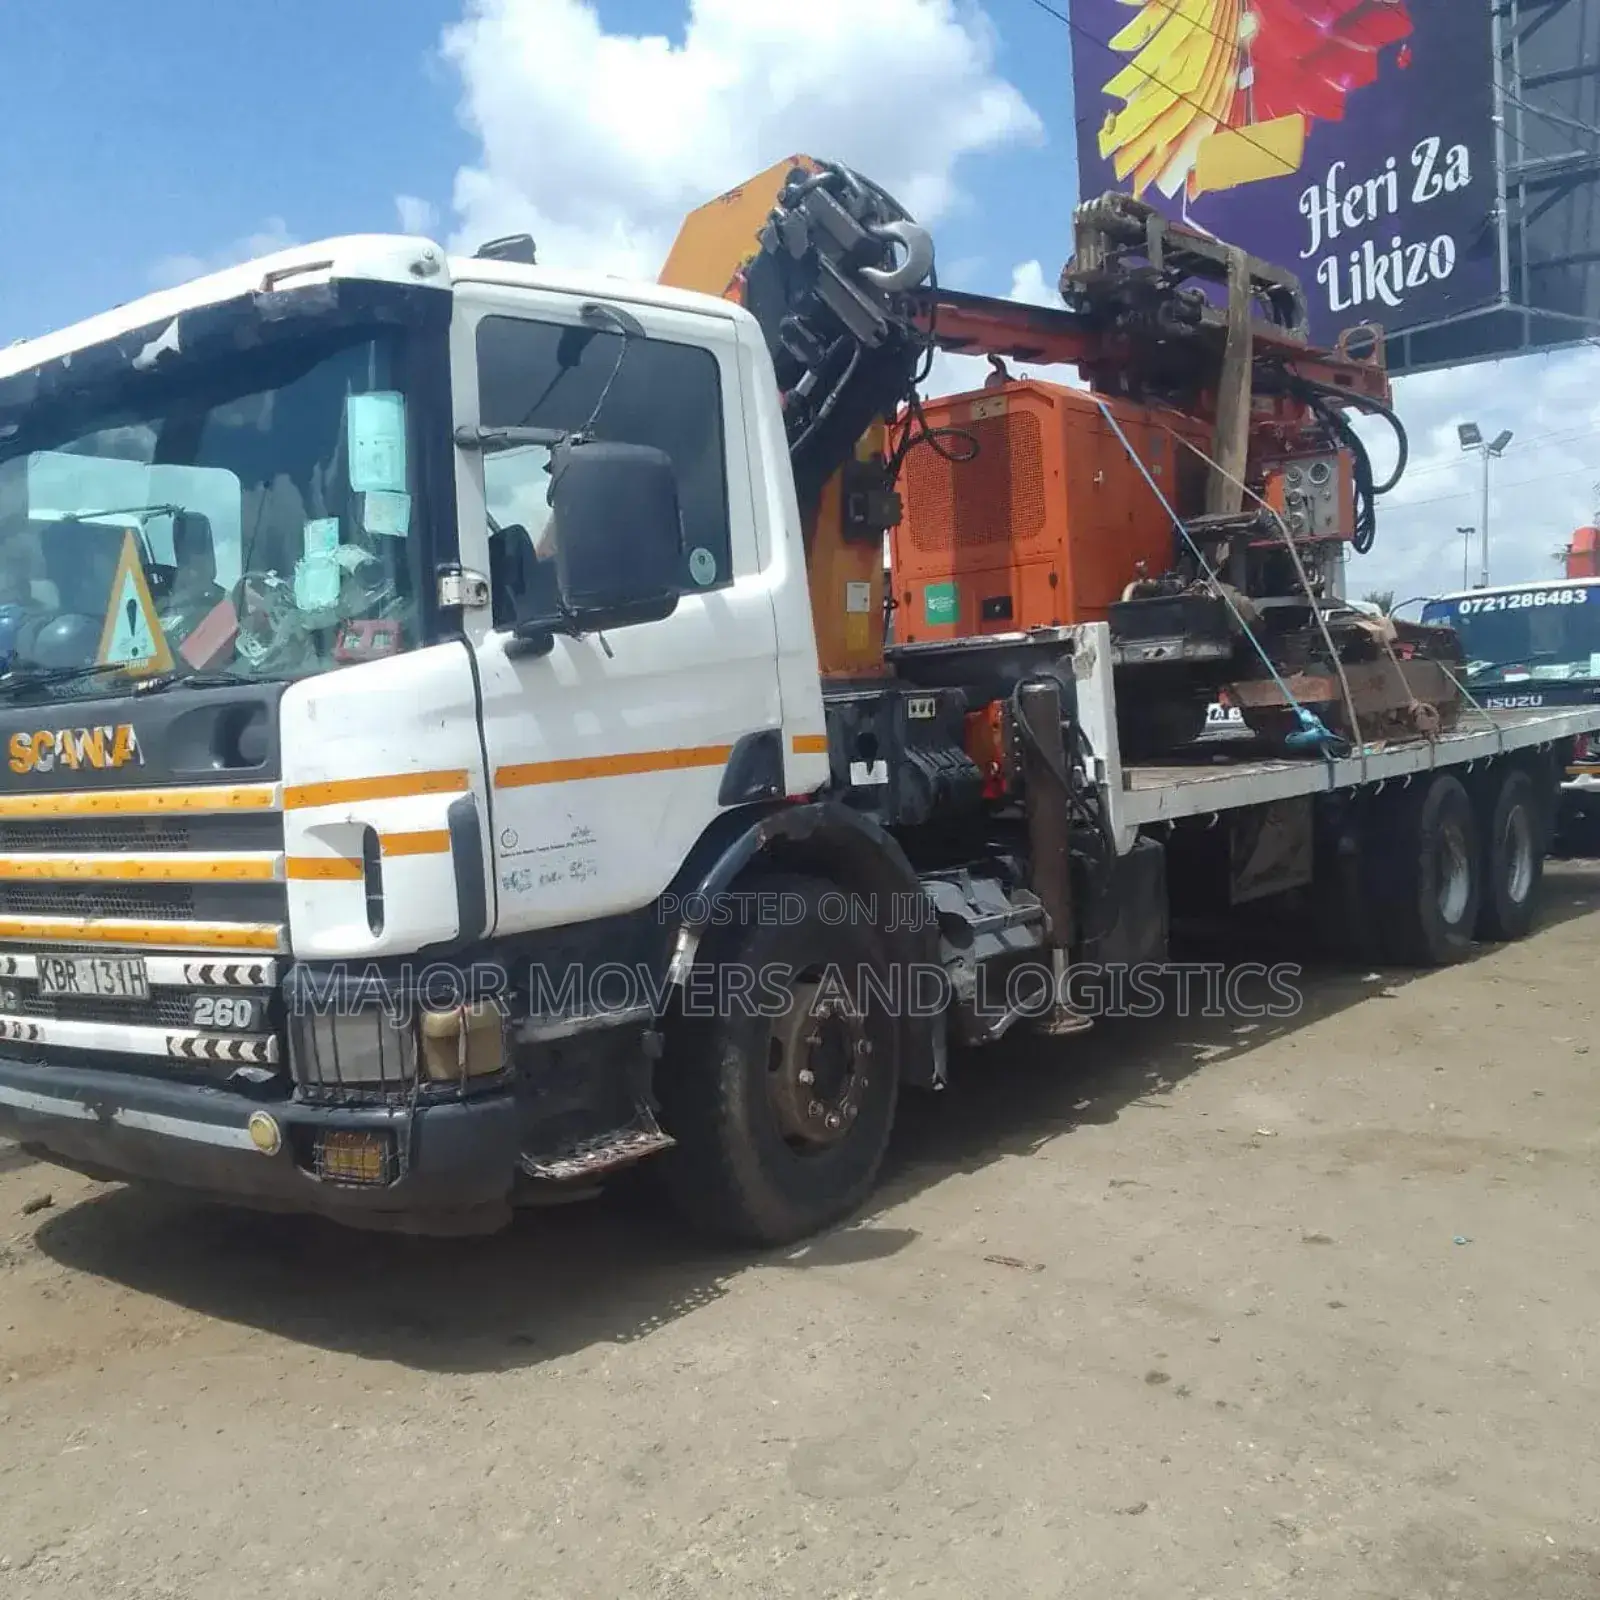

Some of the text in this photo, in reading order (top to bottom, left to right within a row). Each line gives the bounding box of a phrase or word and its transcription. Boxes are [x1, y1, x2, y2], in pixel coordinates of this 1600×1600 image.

[1299, 136, 1472, 258] Heri Za
[1317, 235, 1456, 312] Likizo
[1458, 588, 1588, 615] 0721286483
[1486, 694, 1543, 709] ISUZU
[41, 958, 145, 995] KBR 131H
[193, 996, 253, 1029] 260
